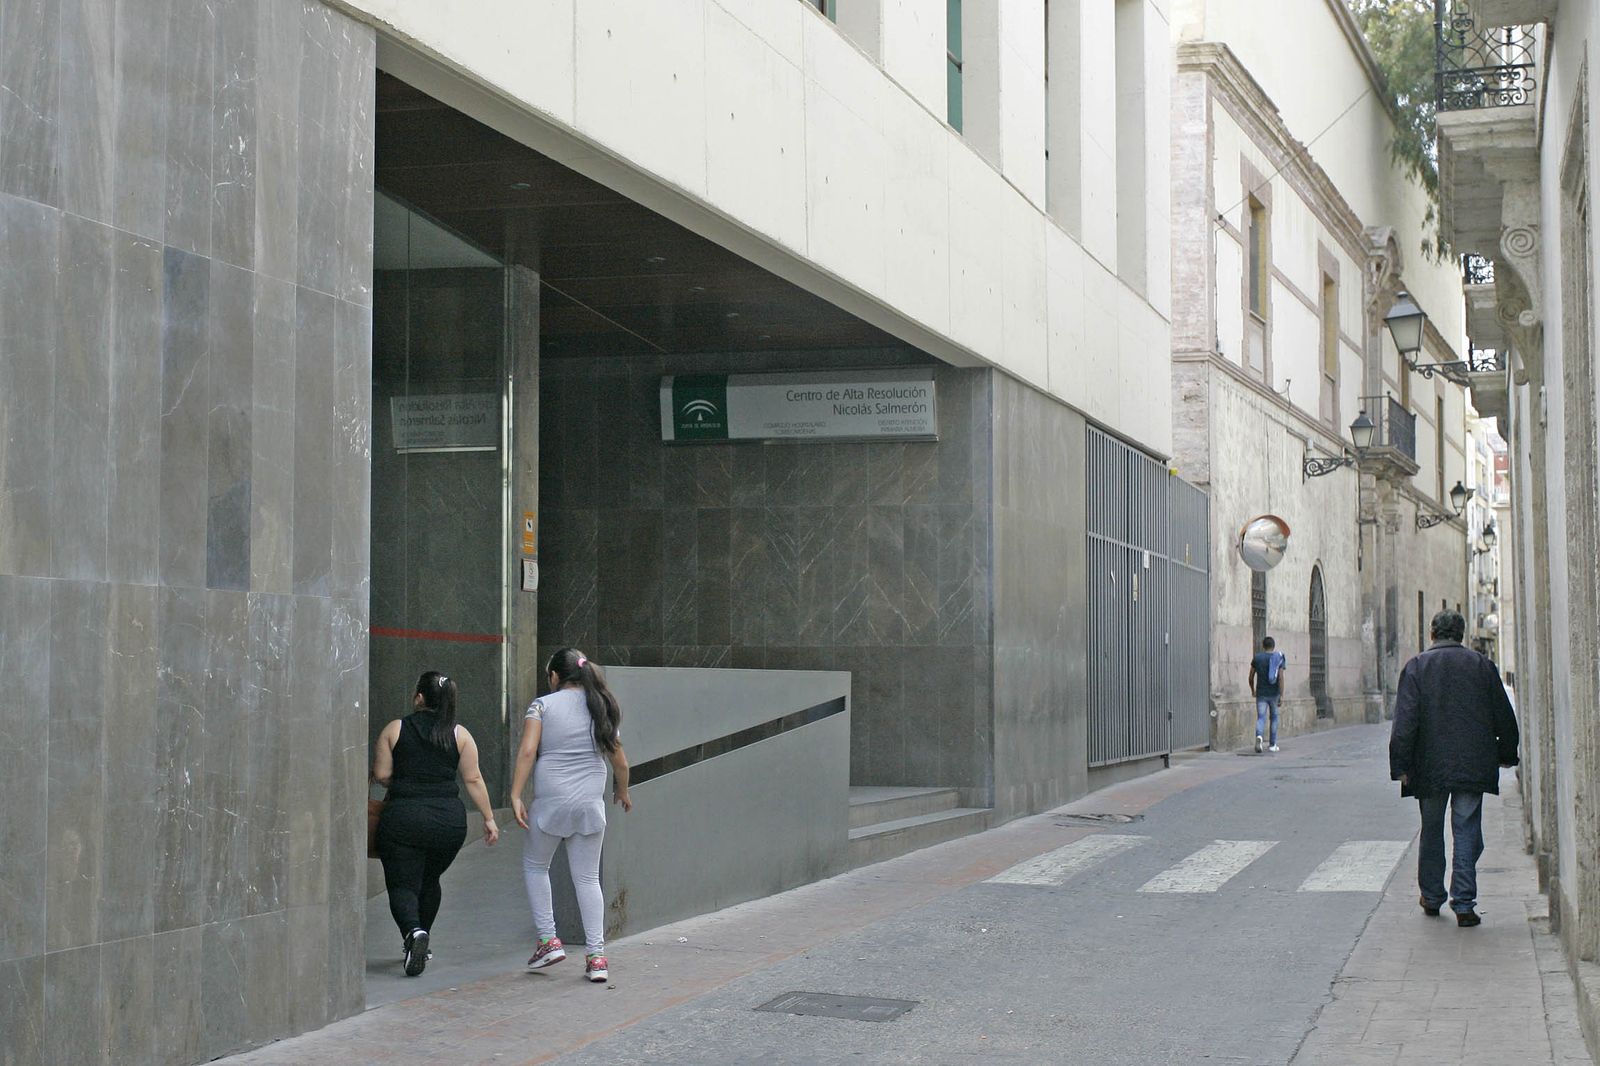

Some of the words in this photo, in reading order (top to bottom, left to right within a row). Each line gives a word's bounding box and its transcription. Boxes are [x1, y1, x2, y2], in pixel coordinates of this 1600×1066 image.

[786, 389, 822, 402] Centro
[825, 389, 840, 400] de
[843, 388, 864, 400] Alta
[867, 386, 926, 399] Resolución
[833, 402, 872, 415] Nicolás
[875, 402, 926, 414] Salmerón
